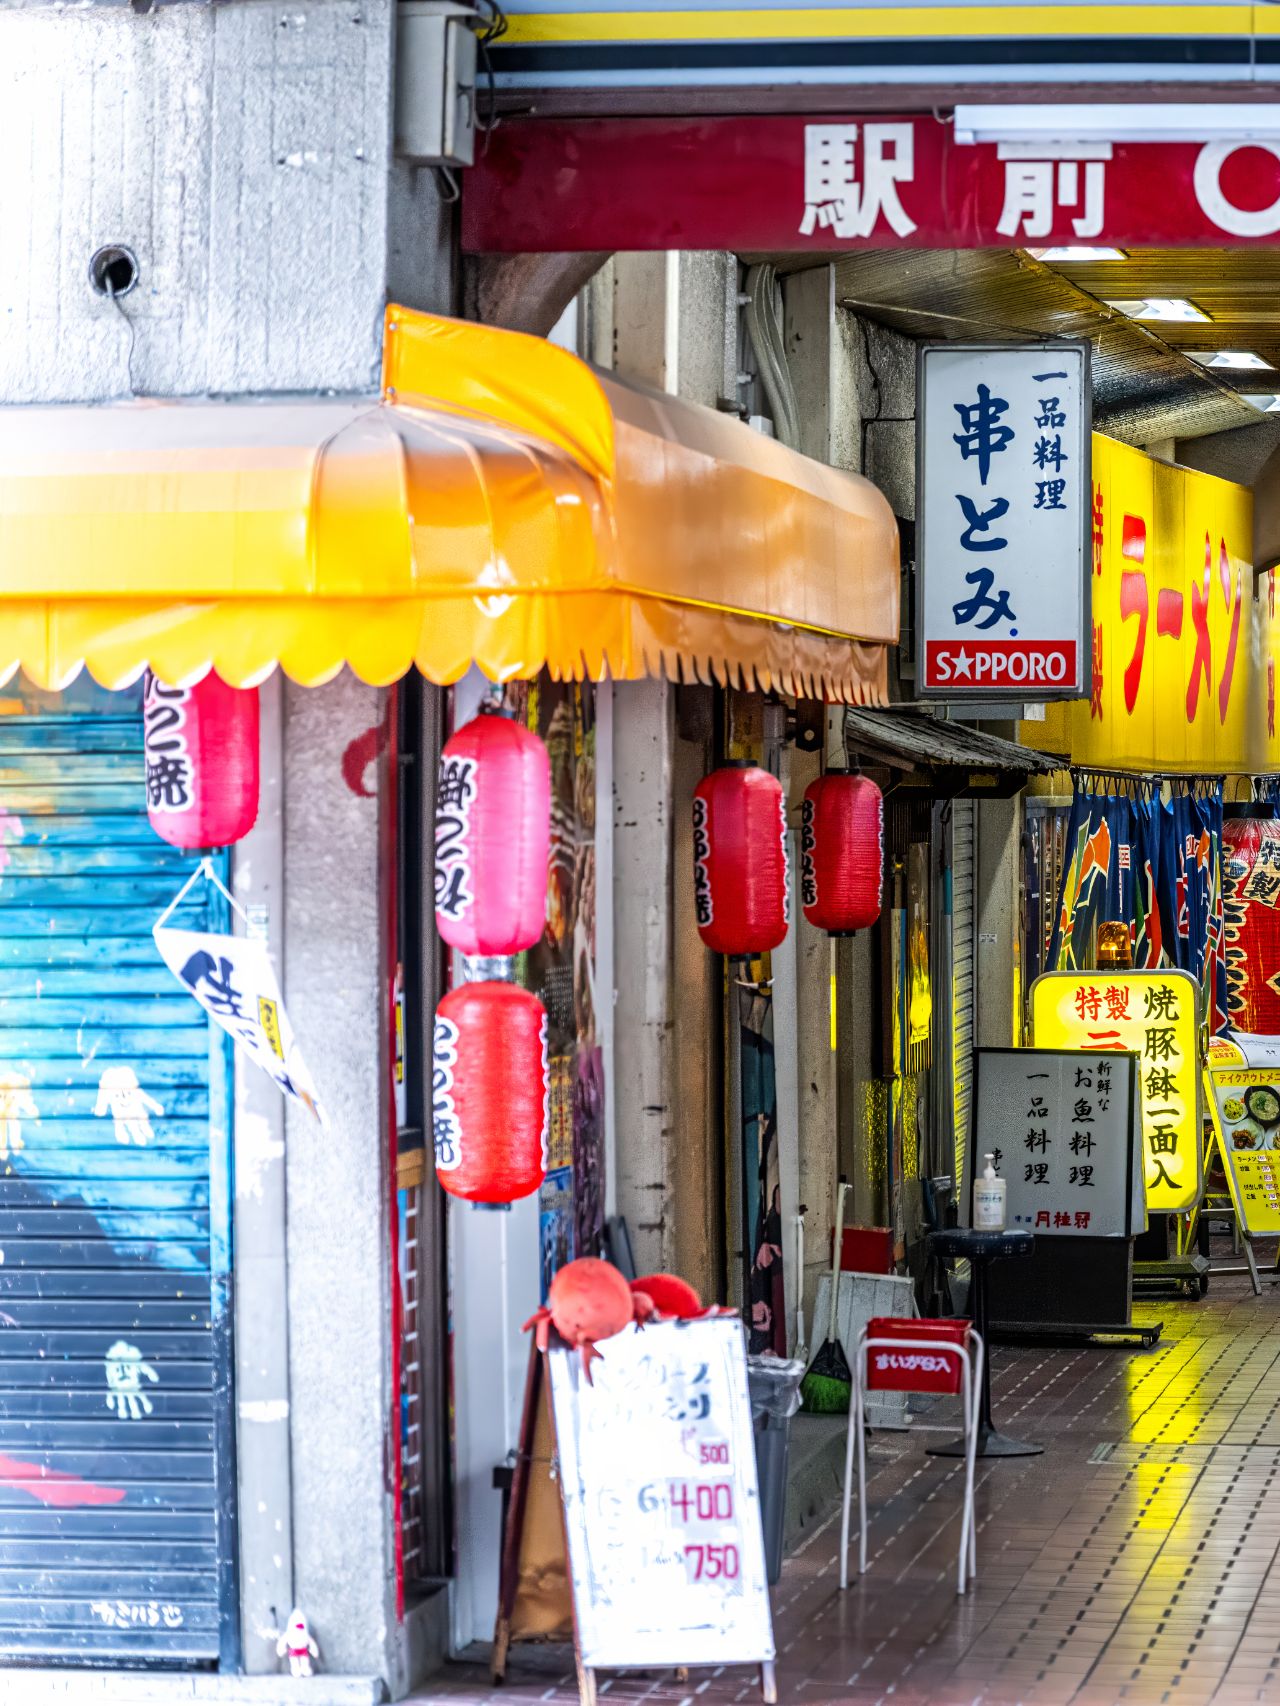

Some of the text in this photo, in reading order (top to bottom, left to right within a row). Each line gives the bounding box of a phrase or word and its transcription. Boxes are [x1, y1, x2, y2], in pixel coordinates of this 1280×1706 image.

[1031, 370, 1069, 510] 一品料理
[952, 383, 1018, 630] 串とみ
[1119, 513, 1242, 726] ラーメン
[1074, 985, 1133, 1022] 特製
[1023, 1072, 1052, 1187] 一品料理
[1068, 1067, 1097, 1188] お魚料理
[1096, 1060, 1113, 1112] 新鮮な
[1143, 984, 1182, 1190] 焼豚鉢一面入
[668, 1483, 734, 1523] 400
[699, 1443, 729, 1466] 500
[683, 1544, 740, 1581] 750
